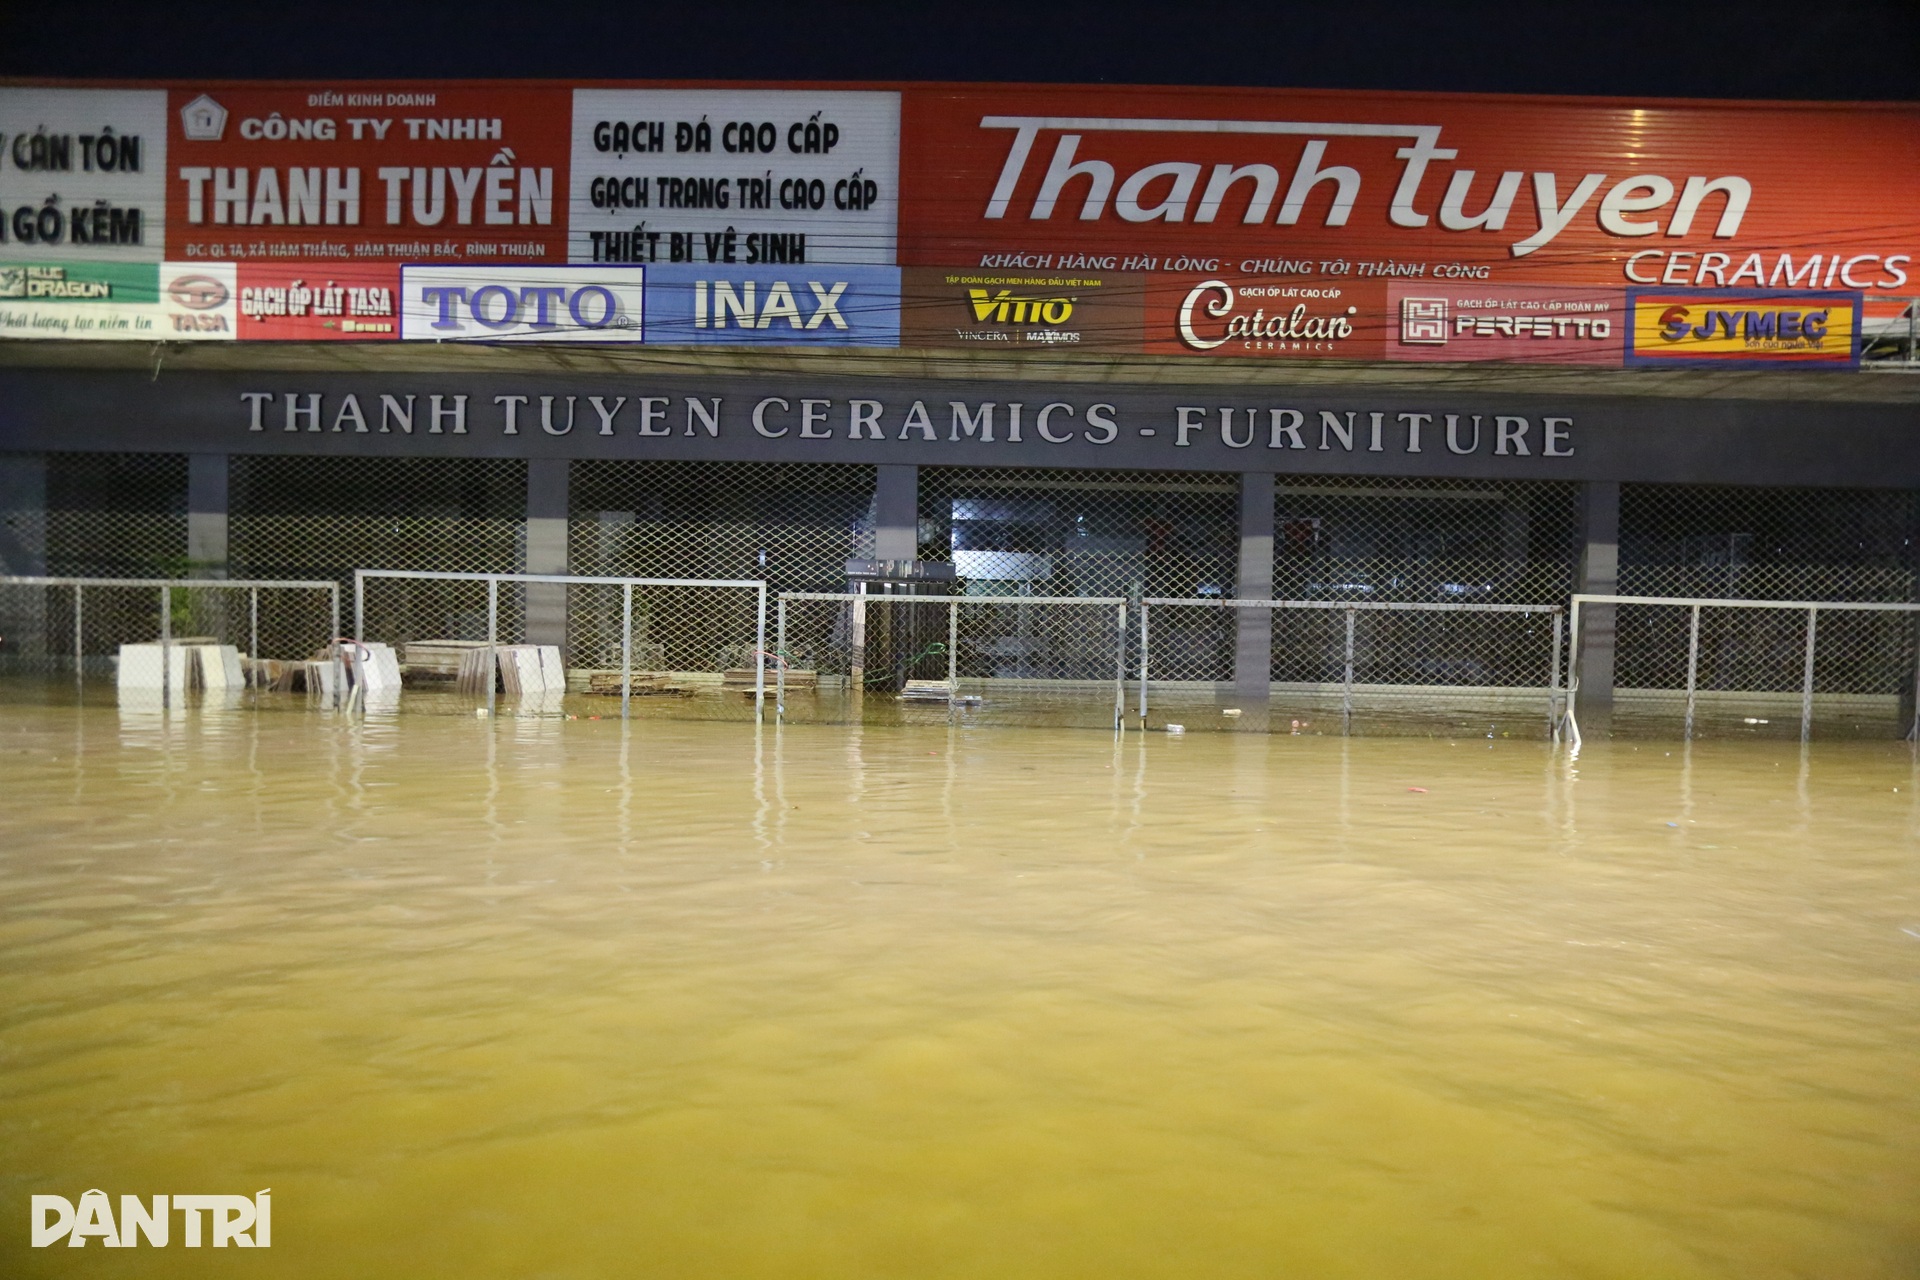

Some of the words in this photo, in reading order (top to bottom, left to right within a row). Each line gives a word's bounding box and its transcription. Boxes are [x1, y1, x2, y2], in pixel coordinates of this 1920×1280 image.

[347, 94, 382, 106] KINH
[386, 94, 436, 106] DOANH
[240, 112, 336, 140] CÔNG
[346, 118, 393, 140] TY
[403, 118, 502, 140] TNHH
[593, 120, 665, 160] GẠCH
[675, 114, 712, 153] ĐÁ
[722, 122, 777, 153] CAO
[787, 110, 840, 154] CẤP
[12, 124, 71, 171] CÁN
[79, 125, 141, 172] TÔN
[180, 166, 360, 225] THANH
[378, 147, 553, 226] TUYỀN
[590, 177, 649, 215] GẠCH
[656, 177, 730, 209] TRANG
[736, 170, 771, 209] TRÍ
[779, 178, 826, 210] CAO
[834, 167, 878, 210] CẤP
[979, 115, 1445, 228] Thanh
[1388, 125, 1752, 258] tuyen
[210, 244, 226, 258] QL
[269, 242, 300, 256] HÀM
[354, 242, 384, 256] HÀM
[466, 242, 497, 256] BÌNH
[501, 242, 546, 260] THUẬN
[590, 221, 660, 263] THIẾT
[746, 233, 805, 265] SINH
[961, 276, 983, 285] ĐOÀN
[1006, 277, 1023, 285] MEN
[1024, 278, 1047, 286] HÀNG
[1083, 279, 1102, 287] NAM
[980, 251, 1052, 269] KHÁCH
[1057, 252, 1116, 270] HÀNG
[1121, 253, 1157, 271] HÀI
[1163, 255, 1219, 272] LÒNG
[1240, 256, 1313, 275] CHÚNG
[1357, 259, 1426, 278] THÀNH
[1433, 262, 1491, 279] CÔNG
[1624, 249, 1912, 289] CERAMICS
[241, 287, 287, 321] GẠCH
[314, 280, 344, 315] LÁT
[349, 288, 392, 316] TASA
[422, 285, 616, 331] TOTO
[695, 280, 849, 329] INAX
[1239, 287, 1265, 299] GẠCH
[1282, 287, 1299, 297] LÁT
[1300, 289, 1320, 298] CAO
[1322, 286, 1341, 299] CẤP
[1520, 301, 1540, 310] CAO
[135, 316, 153, 330] tin
[168, 313, 229, 332] TASA
[1456, 315, 1611, 338] PERFETTO
[1244, 341, 1333, 351] CERAMICS
[241, 392, 468, 434] THANH
[495, 395, 724, 437] TUYEN
[751, 398, 1119, 445] CERAMICS
[1175, 406, 1575, 458] FURNITURE
